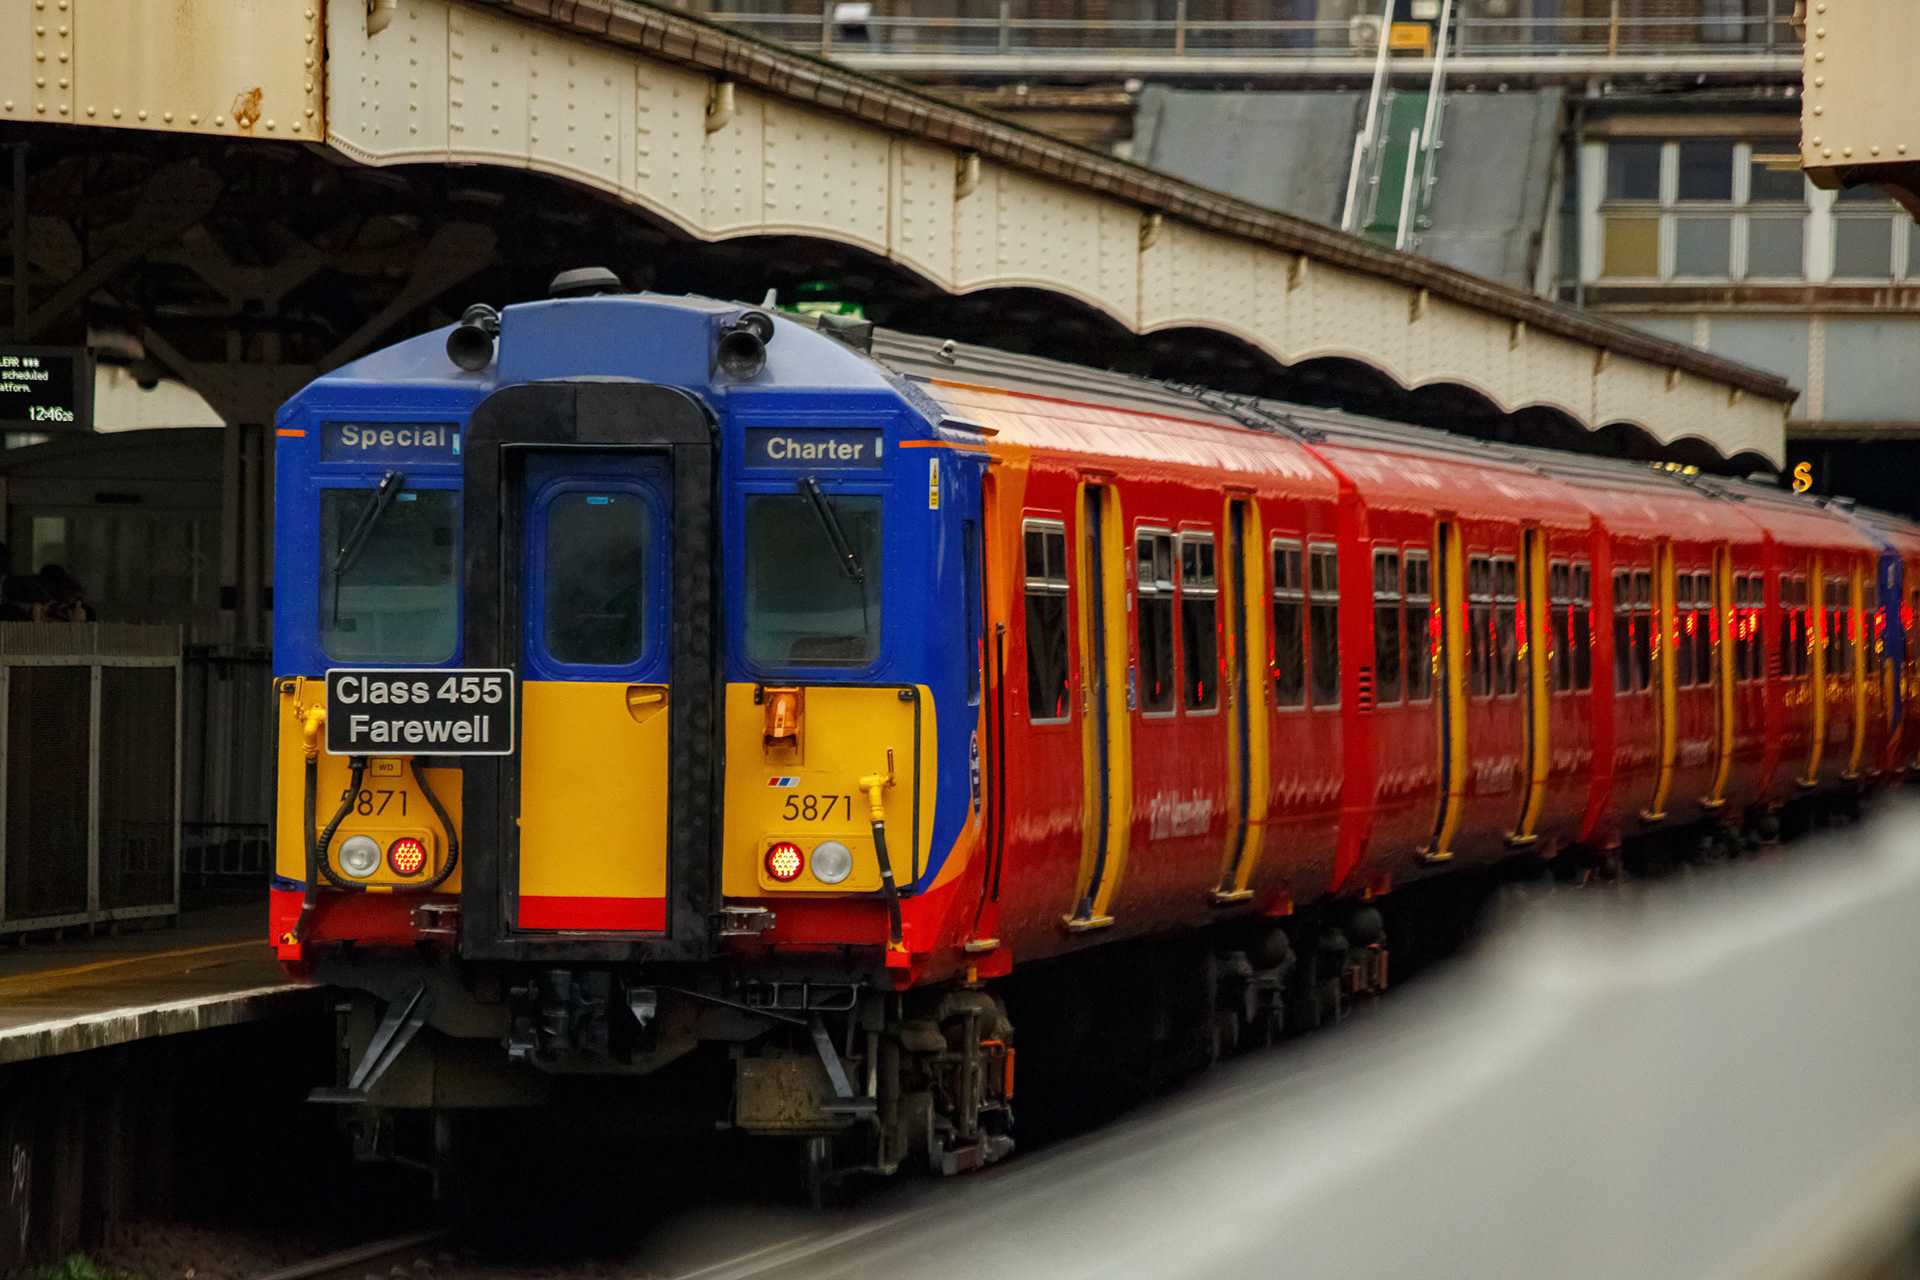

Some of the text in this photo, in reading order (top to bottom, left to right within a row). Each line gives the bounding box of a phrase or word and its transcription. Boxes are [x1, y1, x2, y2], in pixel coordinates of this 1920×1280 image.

[2, 370, 49, 381] scheduled
[341, 424, 445, 450] Special
[767, 437, 864, 460] Charter
[336, 676, 503, 704] Class 455
[350, 715, 490, 743] Farewell
[379, 763, 394, 772] WD
[782, 794, 851, 821] 5871
